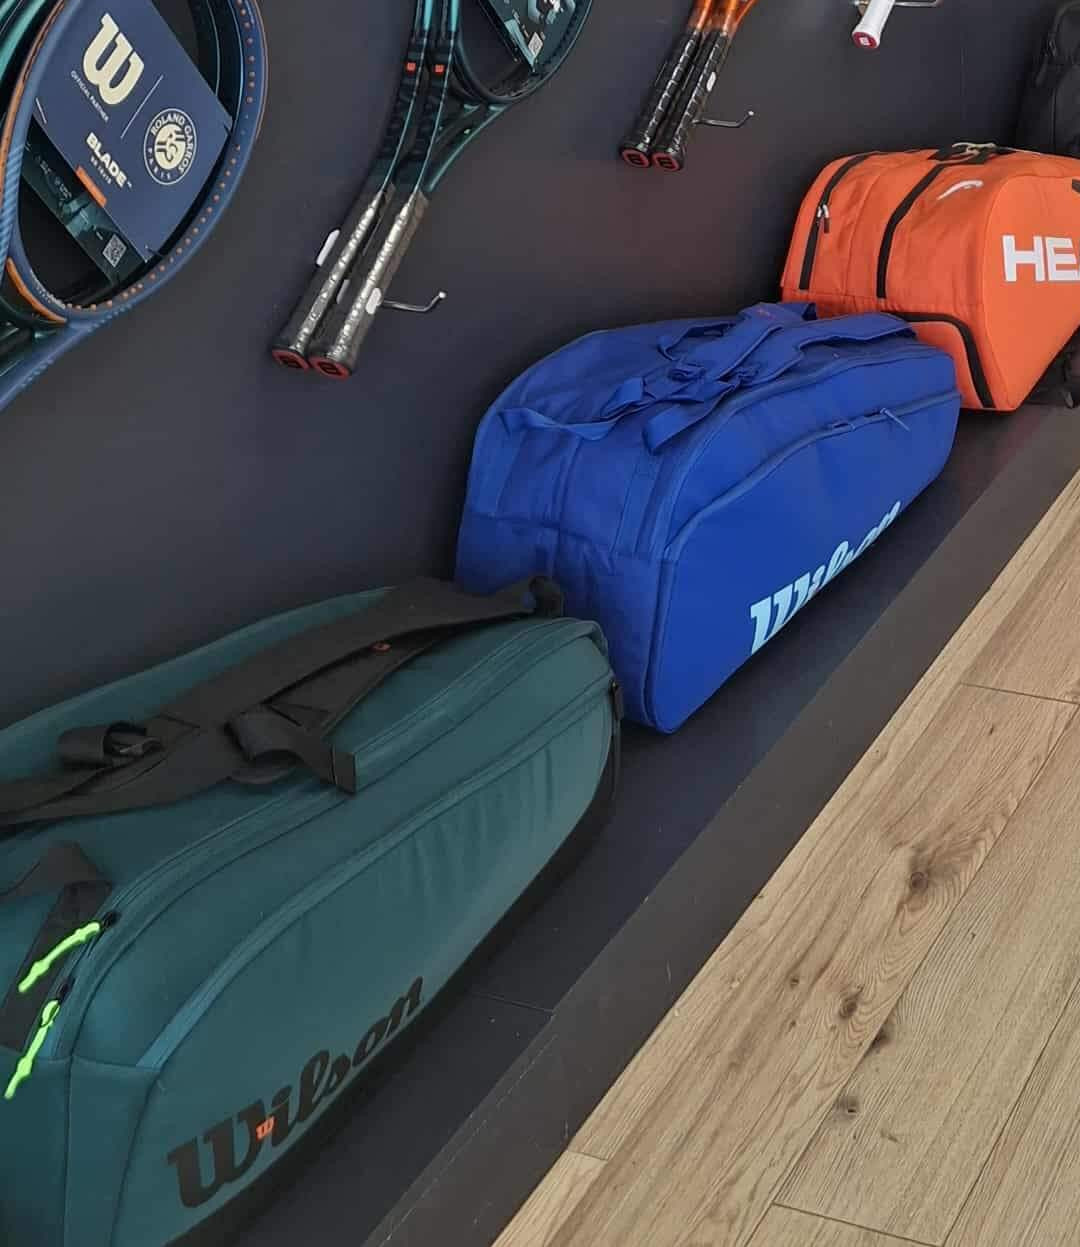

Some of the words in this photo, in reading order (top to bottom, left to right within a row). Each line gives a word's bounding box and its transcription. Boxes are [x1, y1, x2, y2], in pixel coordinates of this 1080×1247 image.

[83, 12, 144, 105] W
[85, 132, 128, 188] BLADE
[150, 112, 185, 136] ROLAND
[178, 124, 194, 174] GARROS
[167, 975, 424, 1210] Wilson
